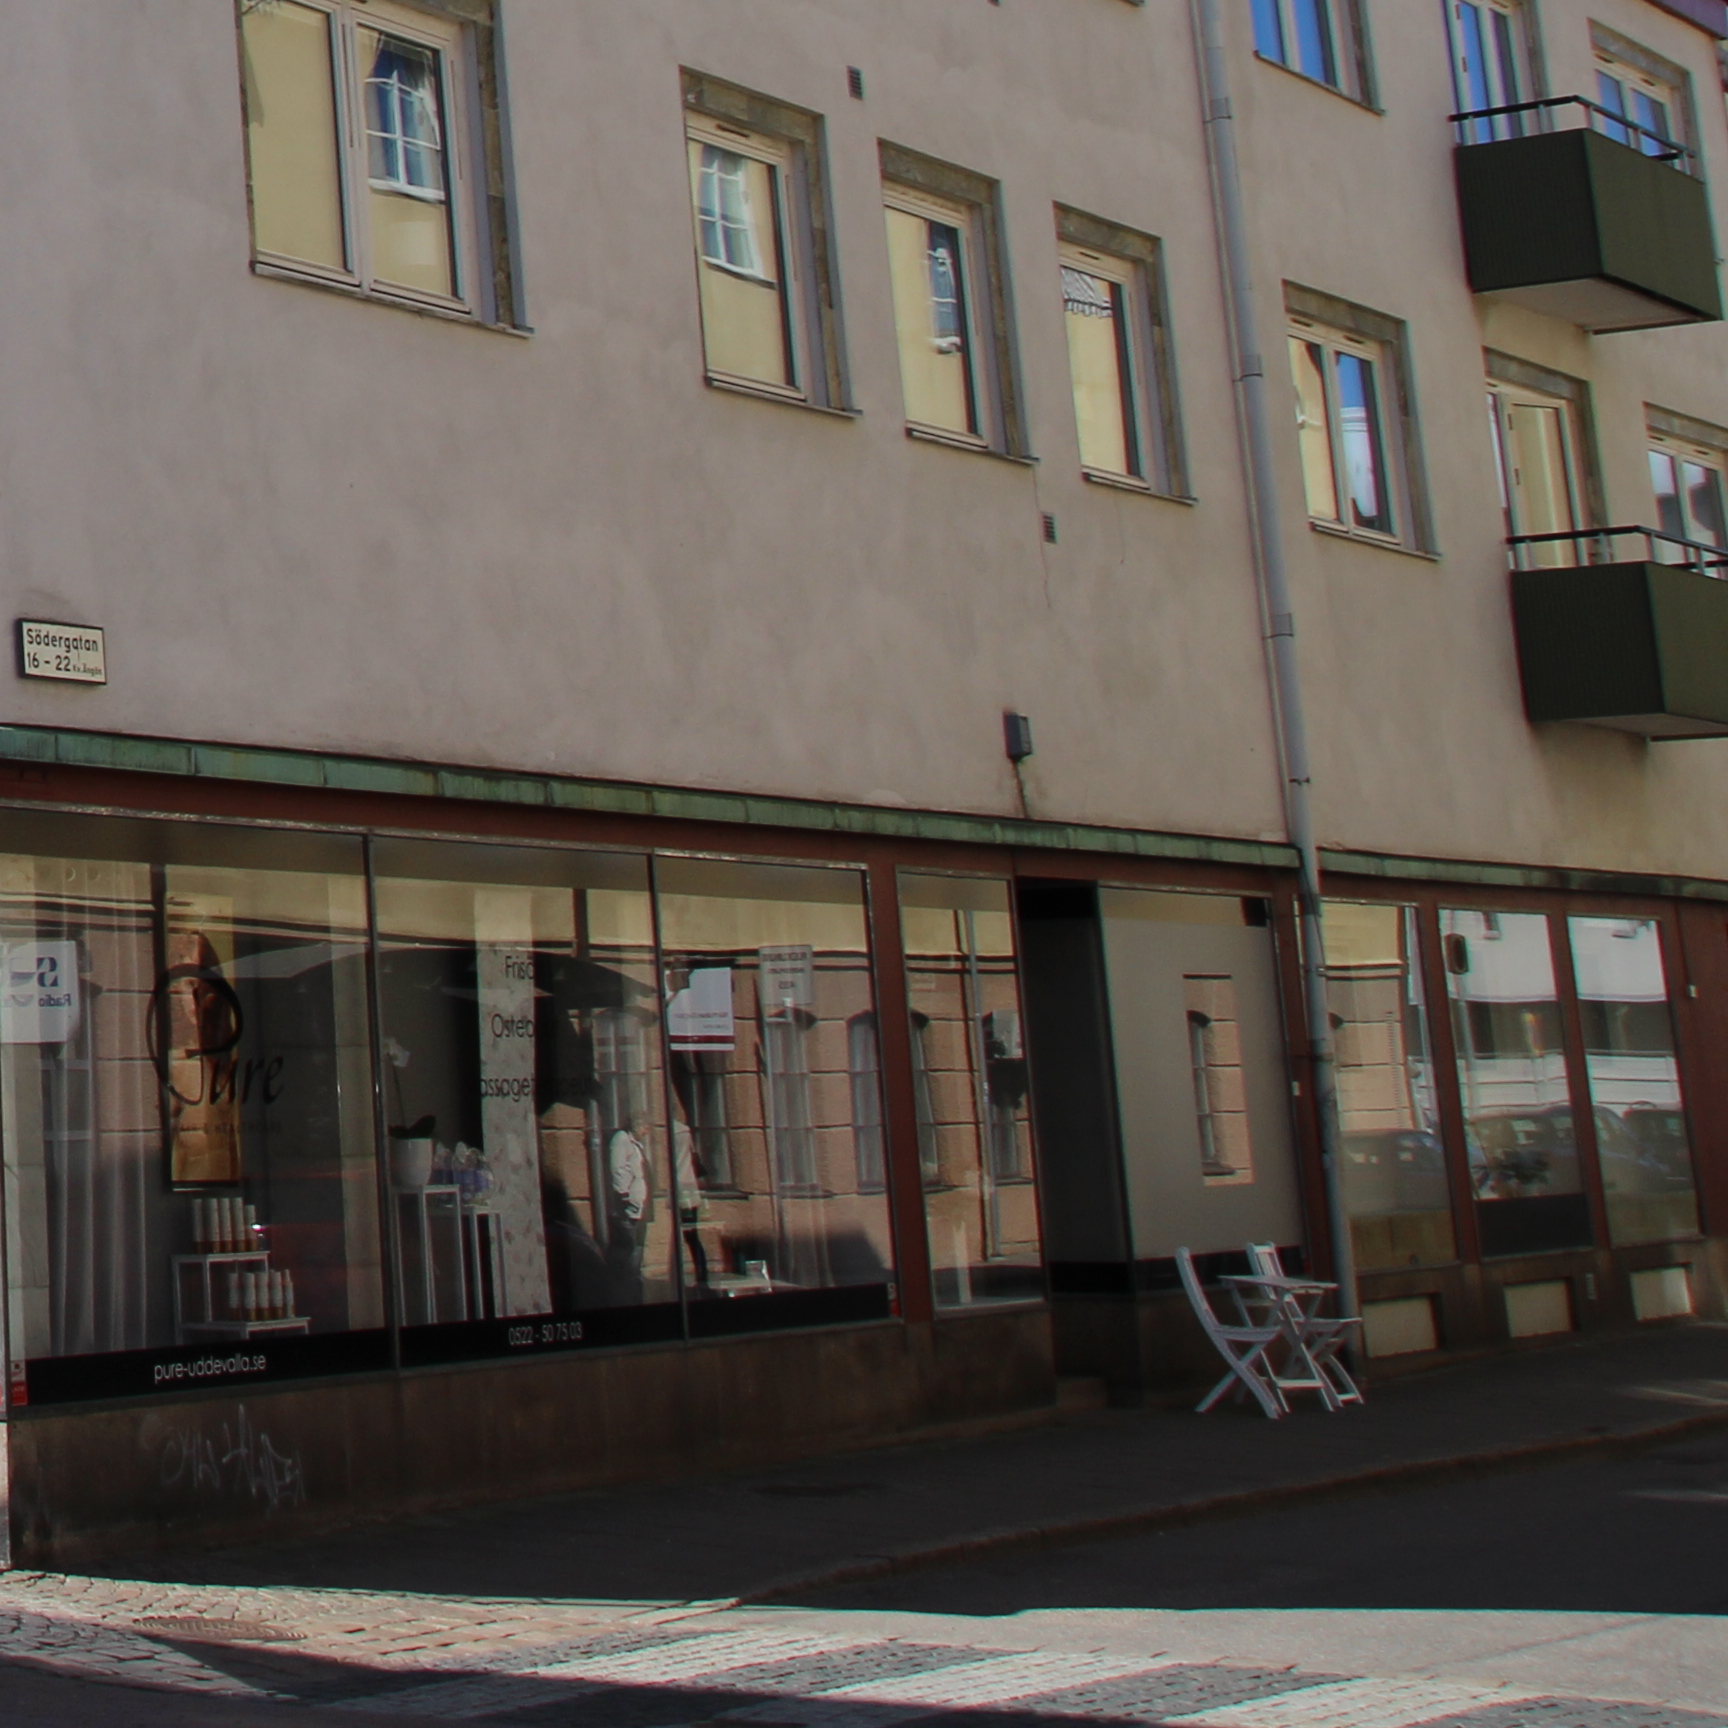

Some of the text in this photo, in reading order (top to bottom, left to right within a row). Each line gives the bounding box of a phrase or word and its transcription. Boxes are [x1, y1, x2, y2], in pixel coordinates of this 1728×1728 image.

[26, 628, 99, 653] Södergatan
[27, 652, 40, 669] 16
[55, 654, 71, 672] 22
[504, 955, 536, 980] Frisö
[145, 963, 285, 1104] Pure
[491, 1013, 538, 1039] Osteo
[153, 1352, 268, 1384] pure-uddevalla.se
